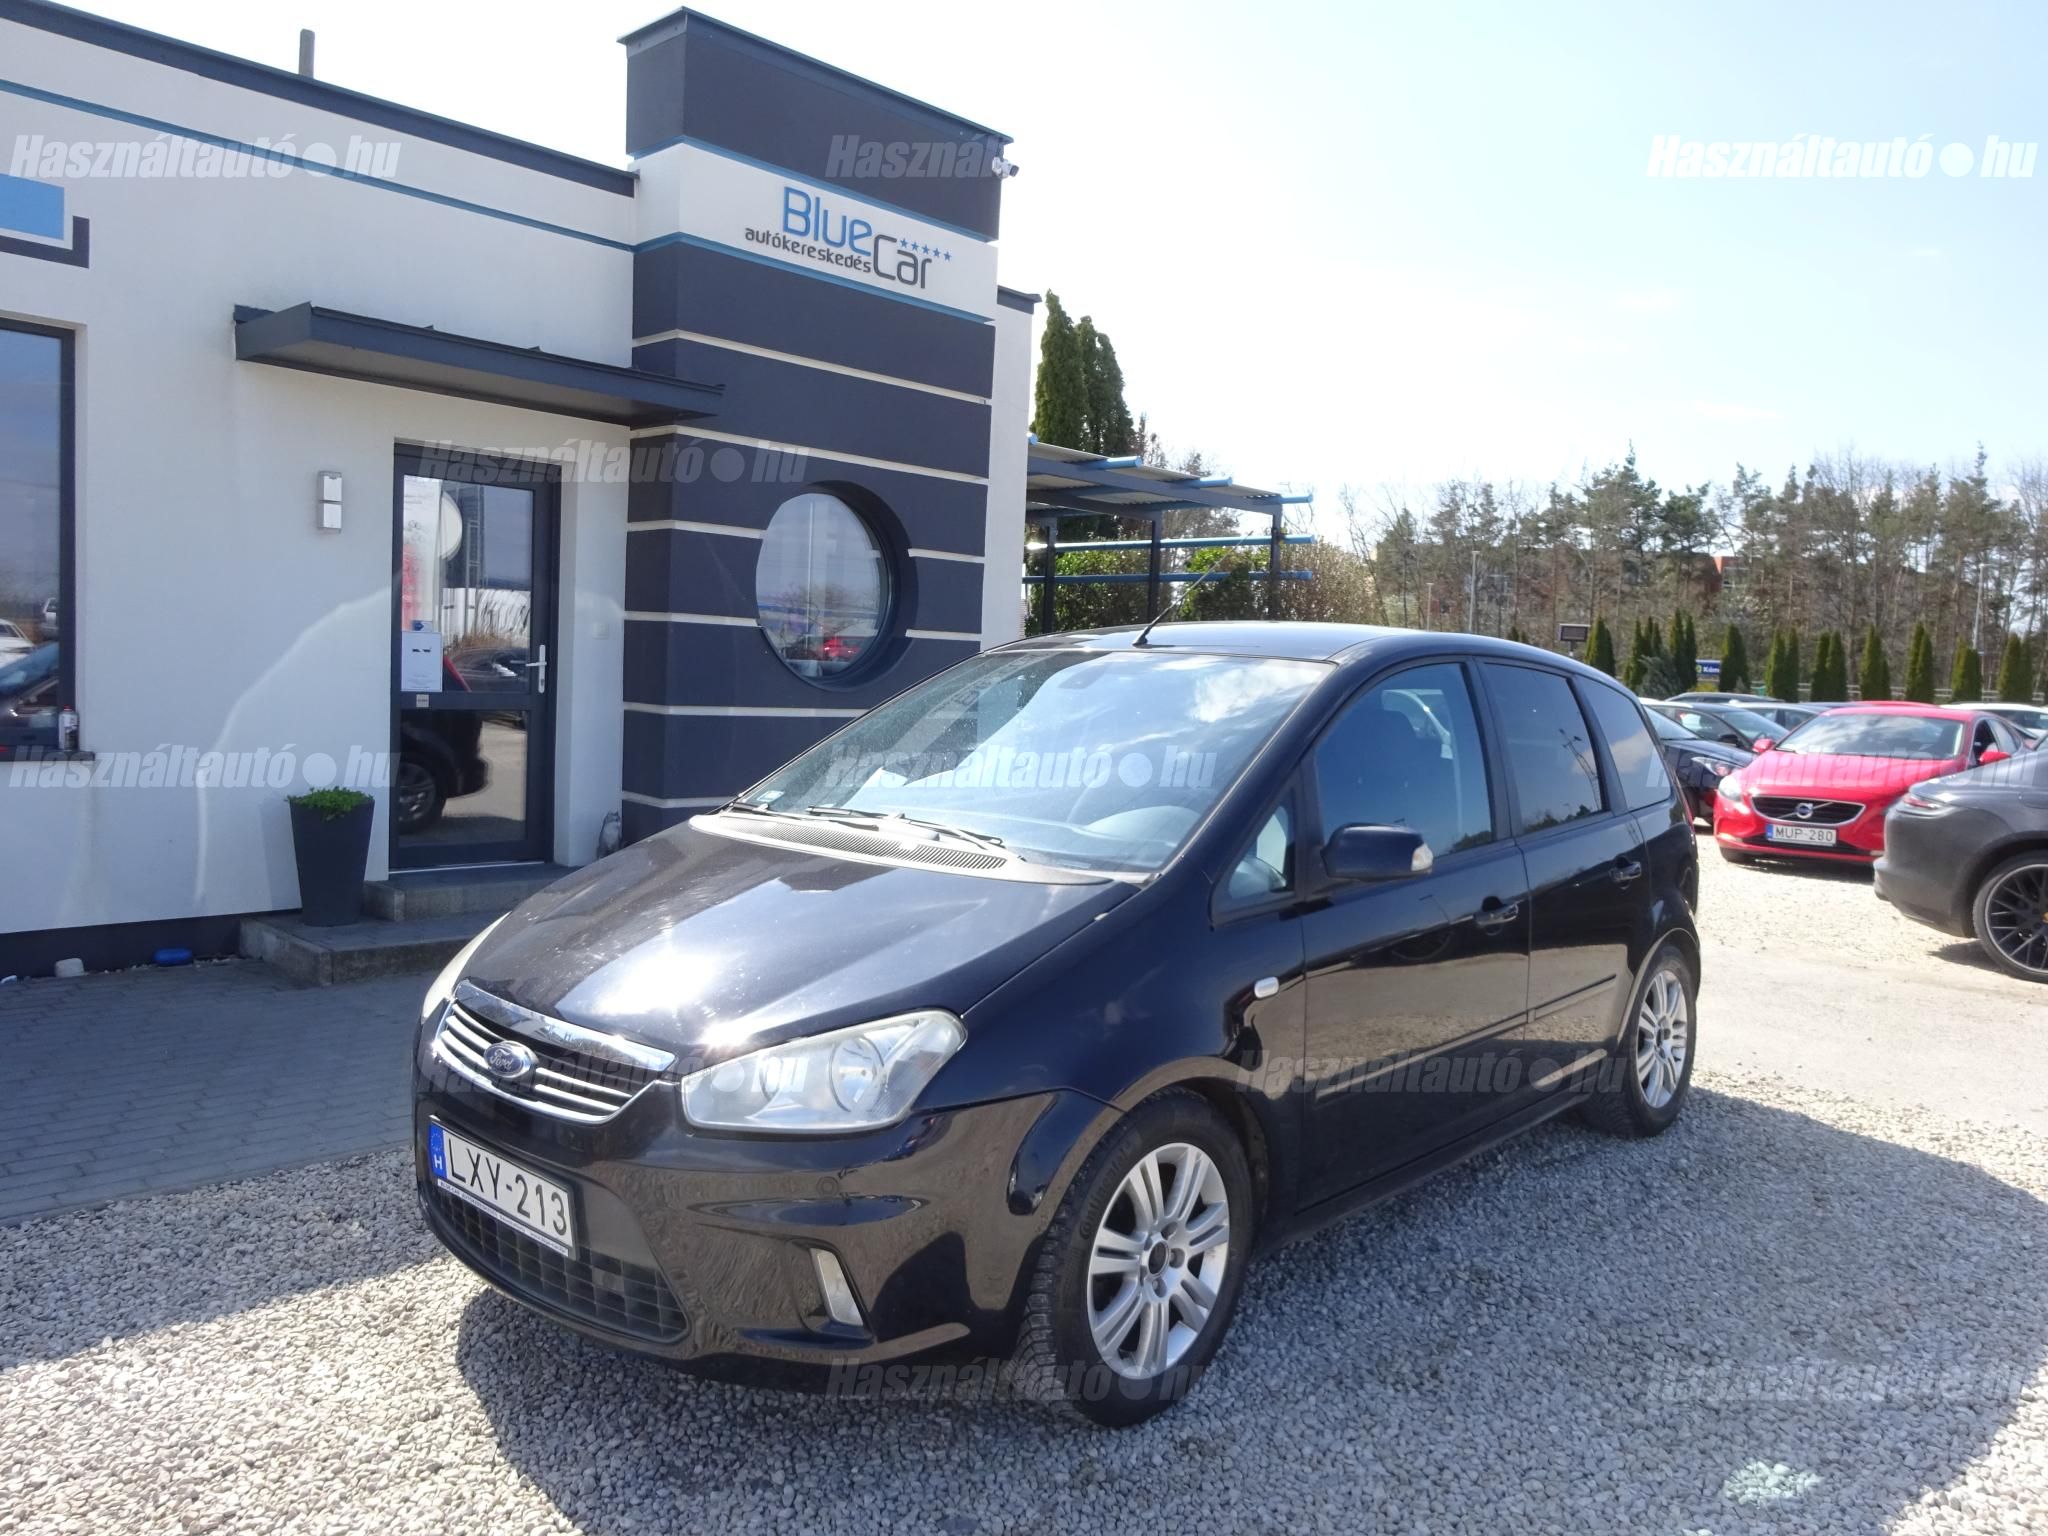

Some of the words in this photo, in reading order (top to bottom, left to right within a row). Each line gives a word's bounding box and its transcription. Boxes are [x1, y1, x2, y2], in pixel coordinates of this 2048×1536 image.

[744, 227, 872, 273] autókereskedés
[1775, 826, 1834, 842] MUP-280
[489, 1048, 514, 1071] Ford
[434, 1153, 443, 1170] H
[448, 1138, 567, 1236] LXY-213
